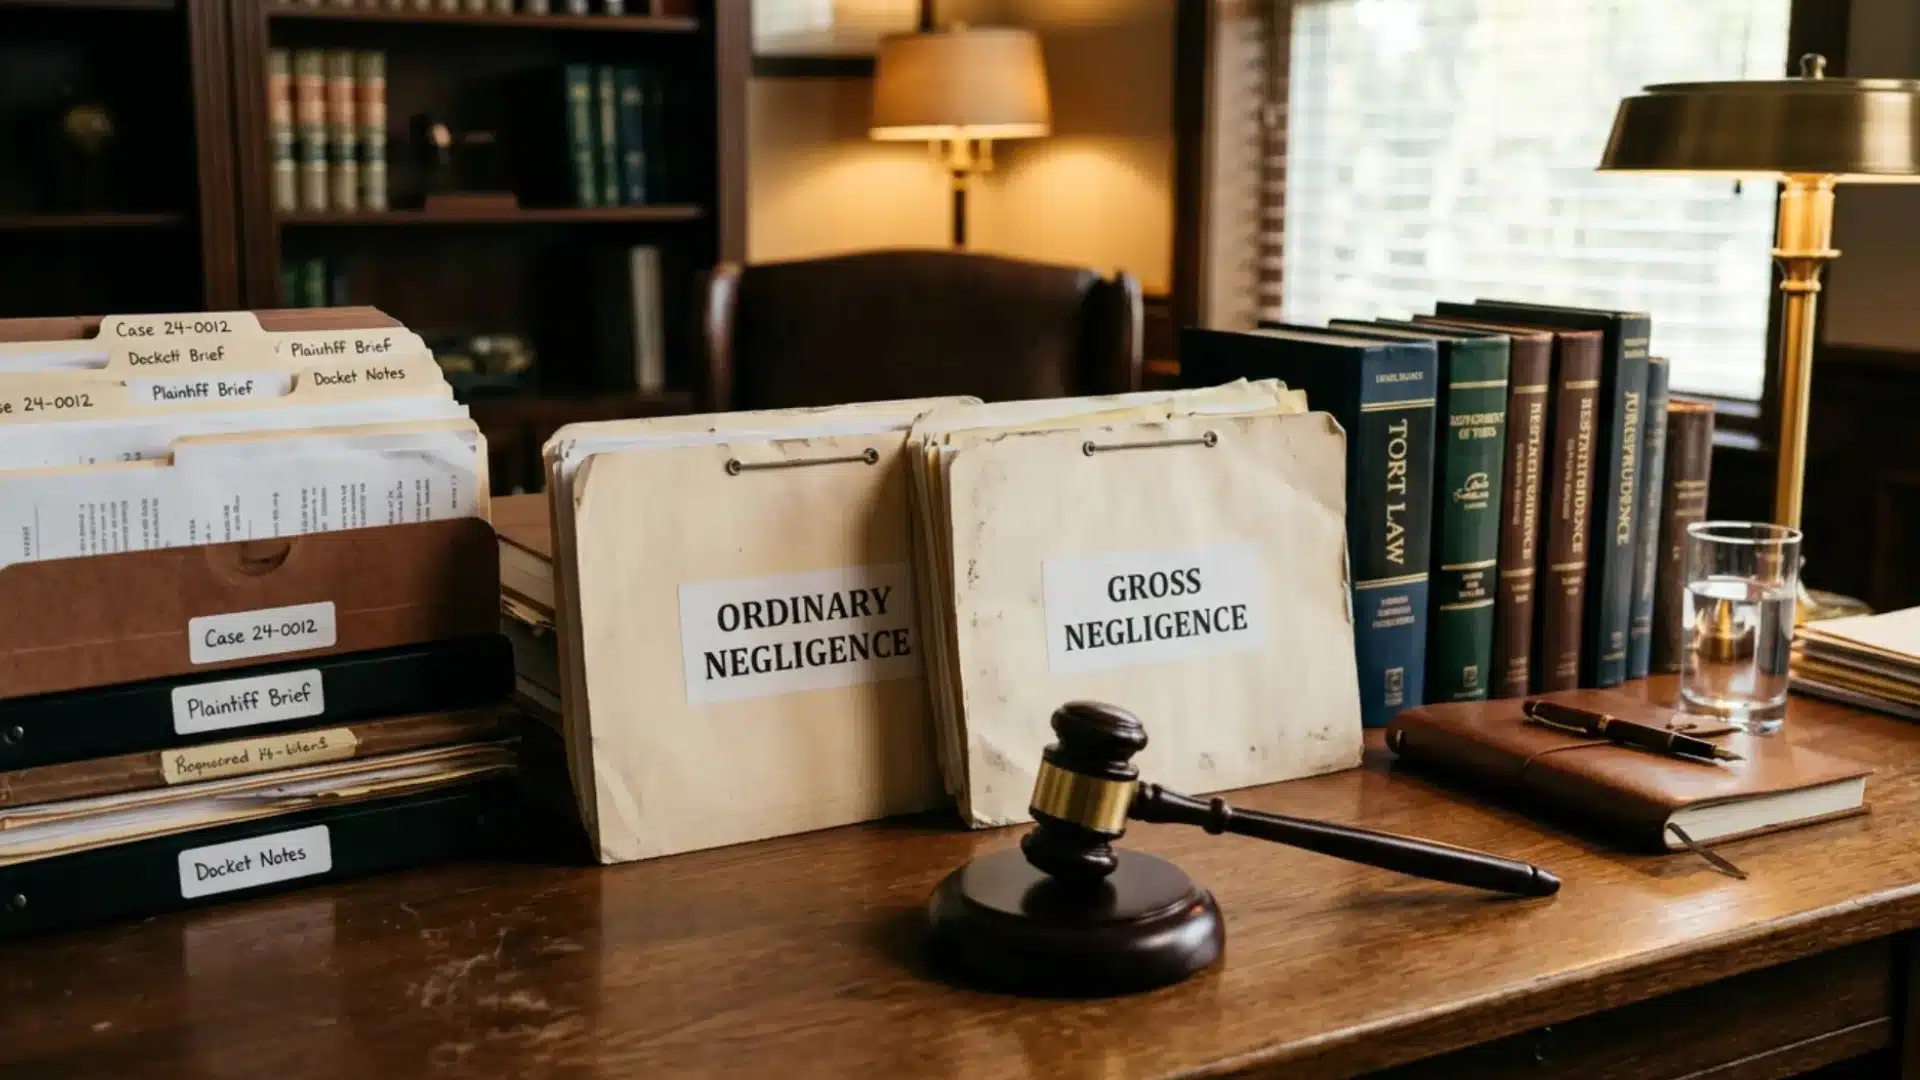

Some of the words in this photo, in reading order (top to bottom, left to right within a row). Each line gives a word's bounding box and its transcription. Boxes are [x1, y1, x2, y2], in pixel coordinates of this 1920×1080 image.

[116, 322, 155, 337] Case
[163, 320, 232, 335] 24-0012
[355, 337, 392, 354] Brief
[189, 345, 225, 363] Brief
[218, 380, 253, 397] Brief
[313, 370, 357, 386] Docket
[366, 366, 406, 381] Notes
[23, 394, 94, 412] 24-0012
[1387, 418, 1408, 495] TORT
[1386, 502, 1406, 565] LAW
[1107, 567, 1202, 602] GROSS
[716, 585, 892, 632] ORDINARY
[205, 628, 245, 648] Case
[252, 618, 318, 641] 24-0012
[1063, 604, 1248, 652] NEGLIGENCE
[703, 628, 912, 680] NEGLIGENCE
[187, 690, 259, 719] Plaintiff
[268, 682, 311, 707] Brief
[194, 855, 252, 881] Docket
[259, 847, 307, 868] Notes
